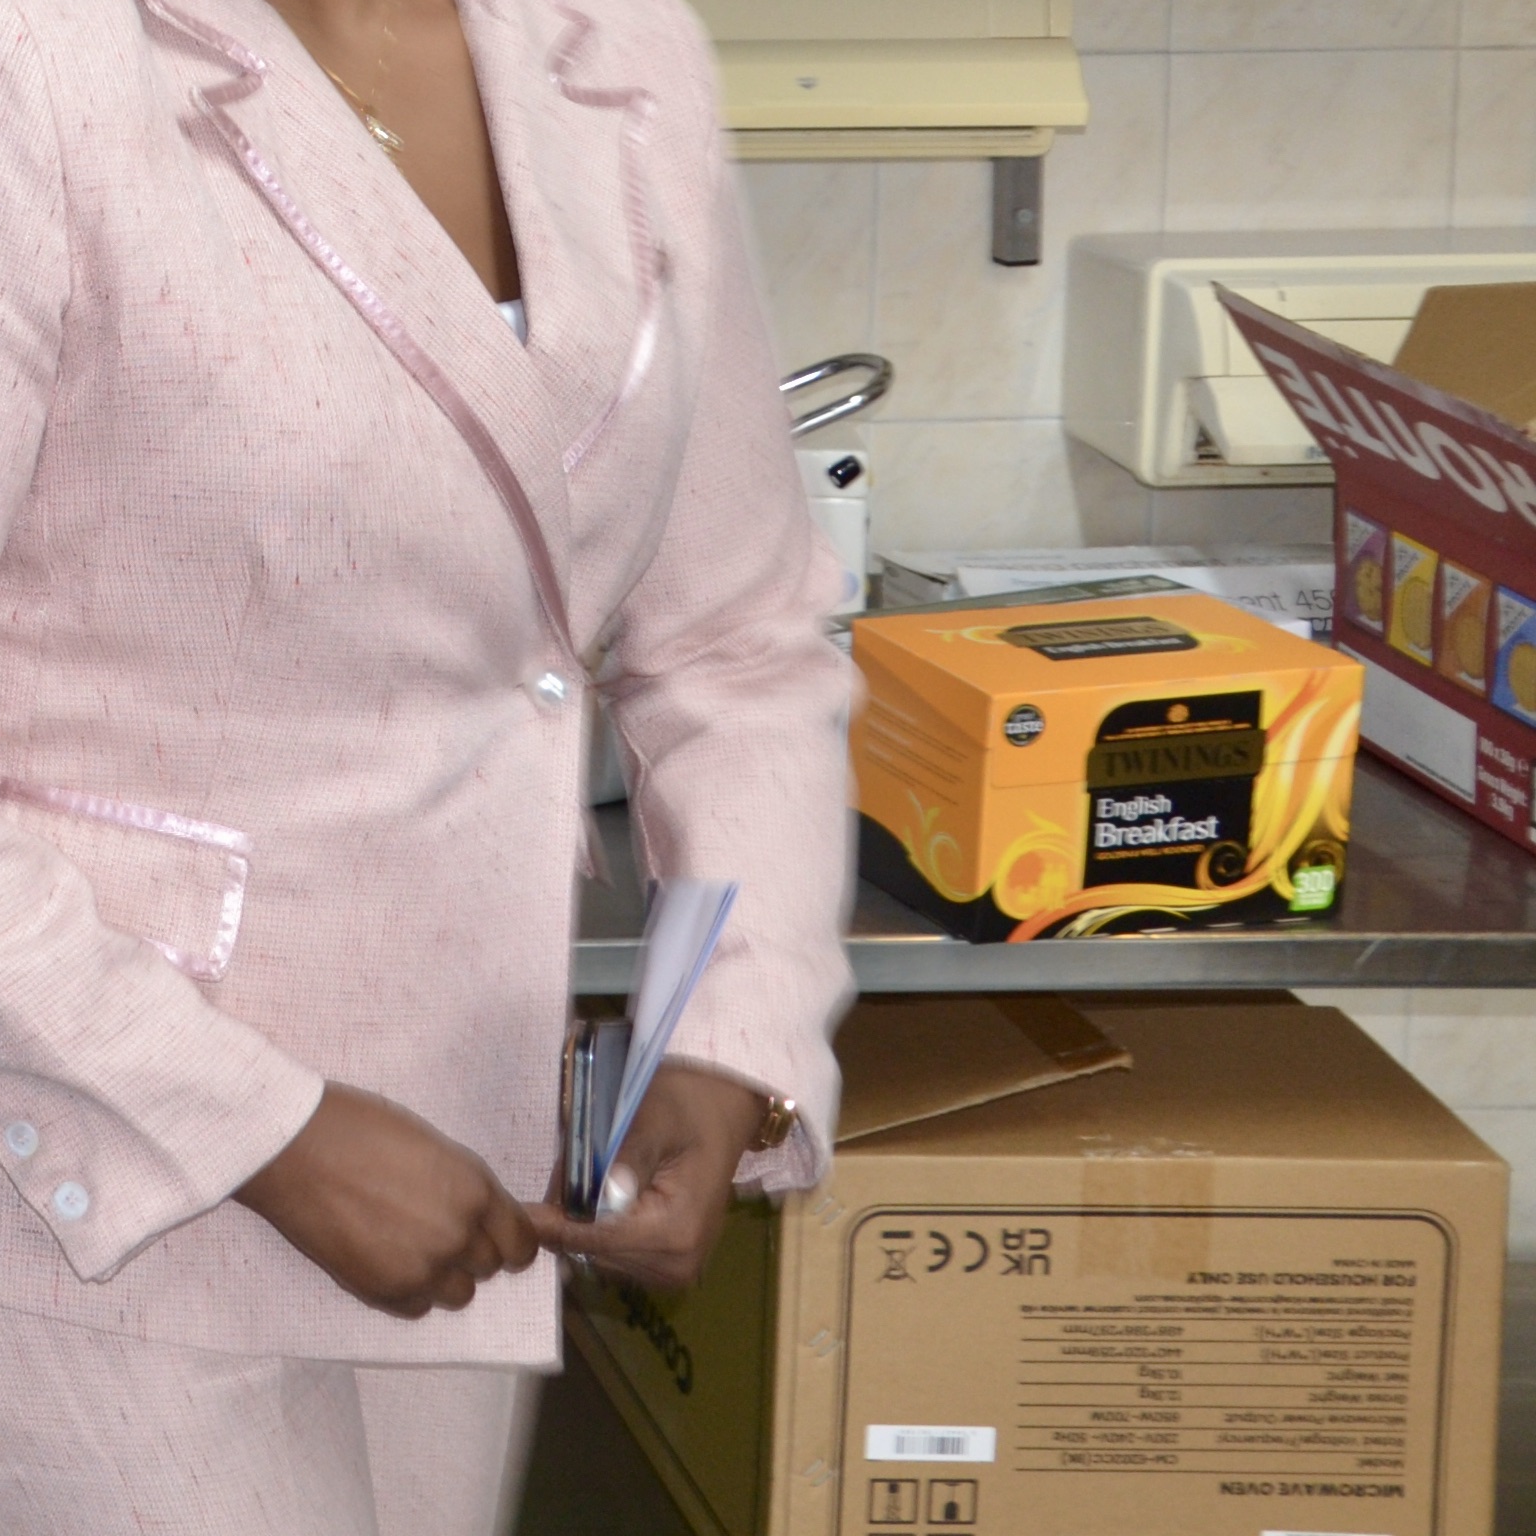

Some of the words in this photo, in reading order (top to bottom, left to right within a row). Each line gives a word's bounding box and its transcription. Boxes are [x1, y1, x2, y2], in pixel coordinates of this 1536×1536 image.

[1103, 741, 1251, 779] TWININGS
[1096, 794, 1173, 821] English
[1093, 814, 1220, 848] Breakfast
[1186, 1272, 1233, 1285] ONLY
[1237, 1273, 1269, 1285] USE
[1274, 1273, 1378, 1287] HOUSEHOLD
[1382, 1274, 1417, 1287] FOR
[1220, 1482, 1274, 1496] OVEN
[1278, 1483, 1405, 1499] MICROWAVE
